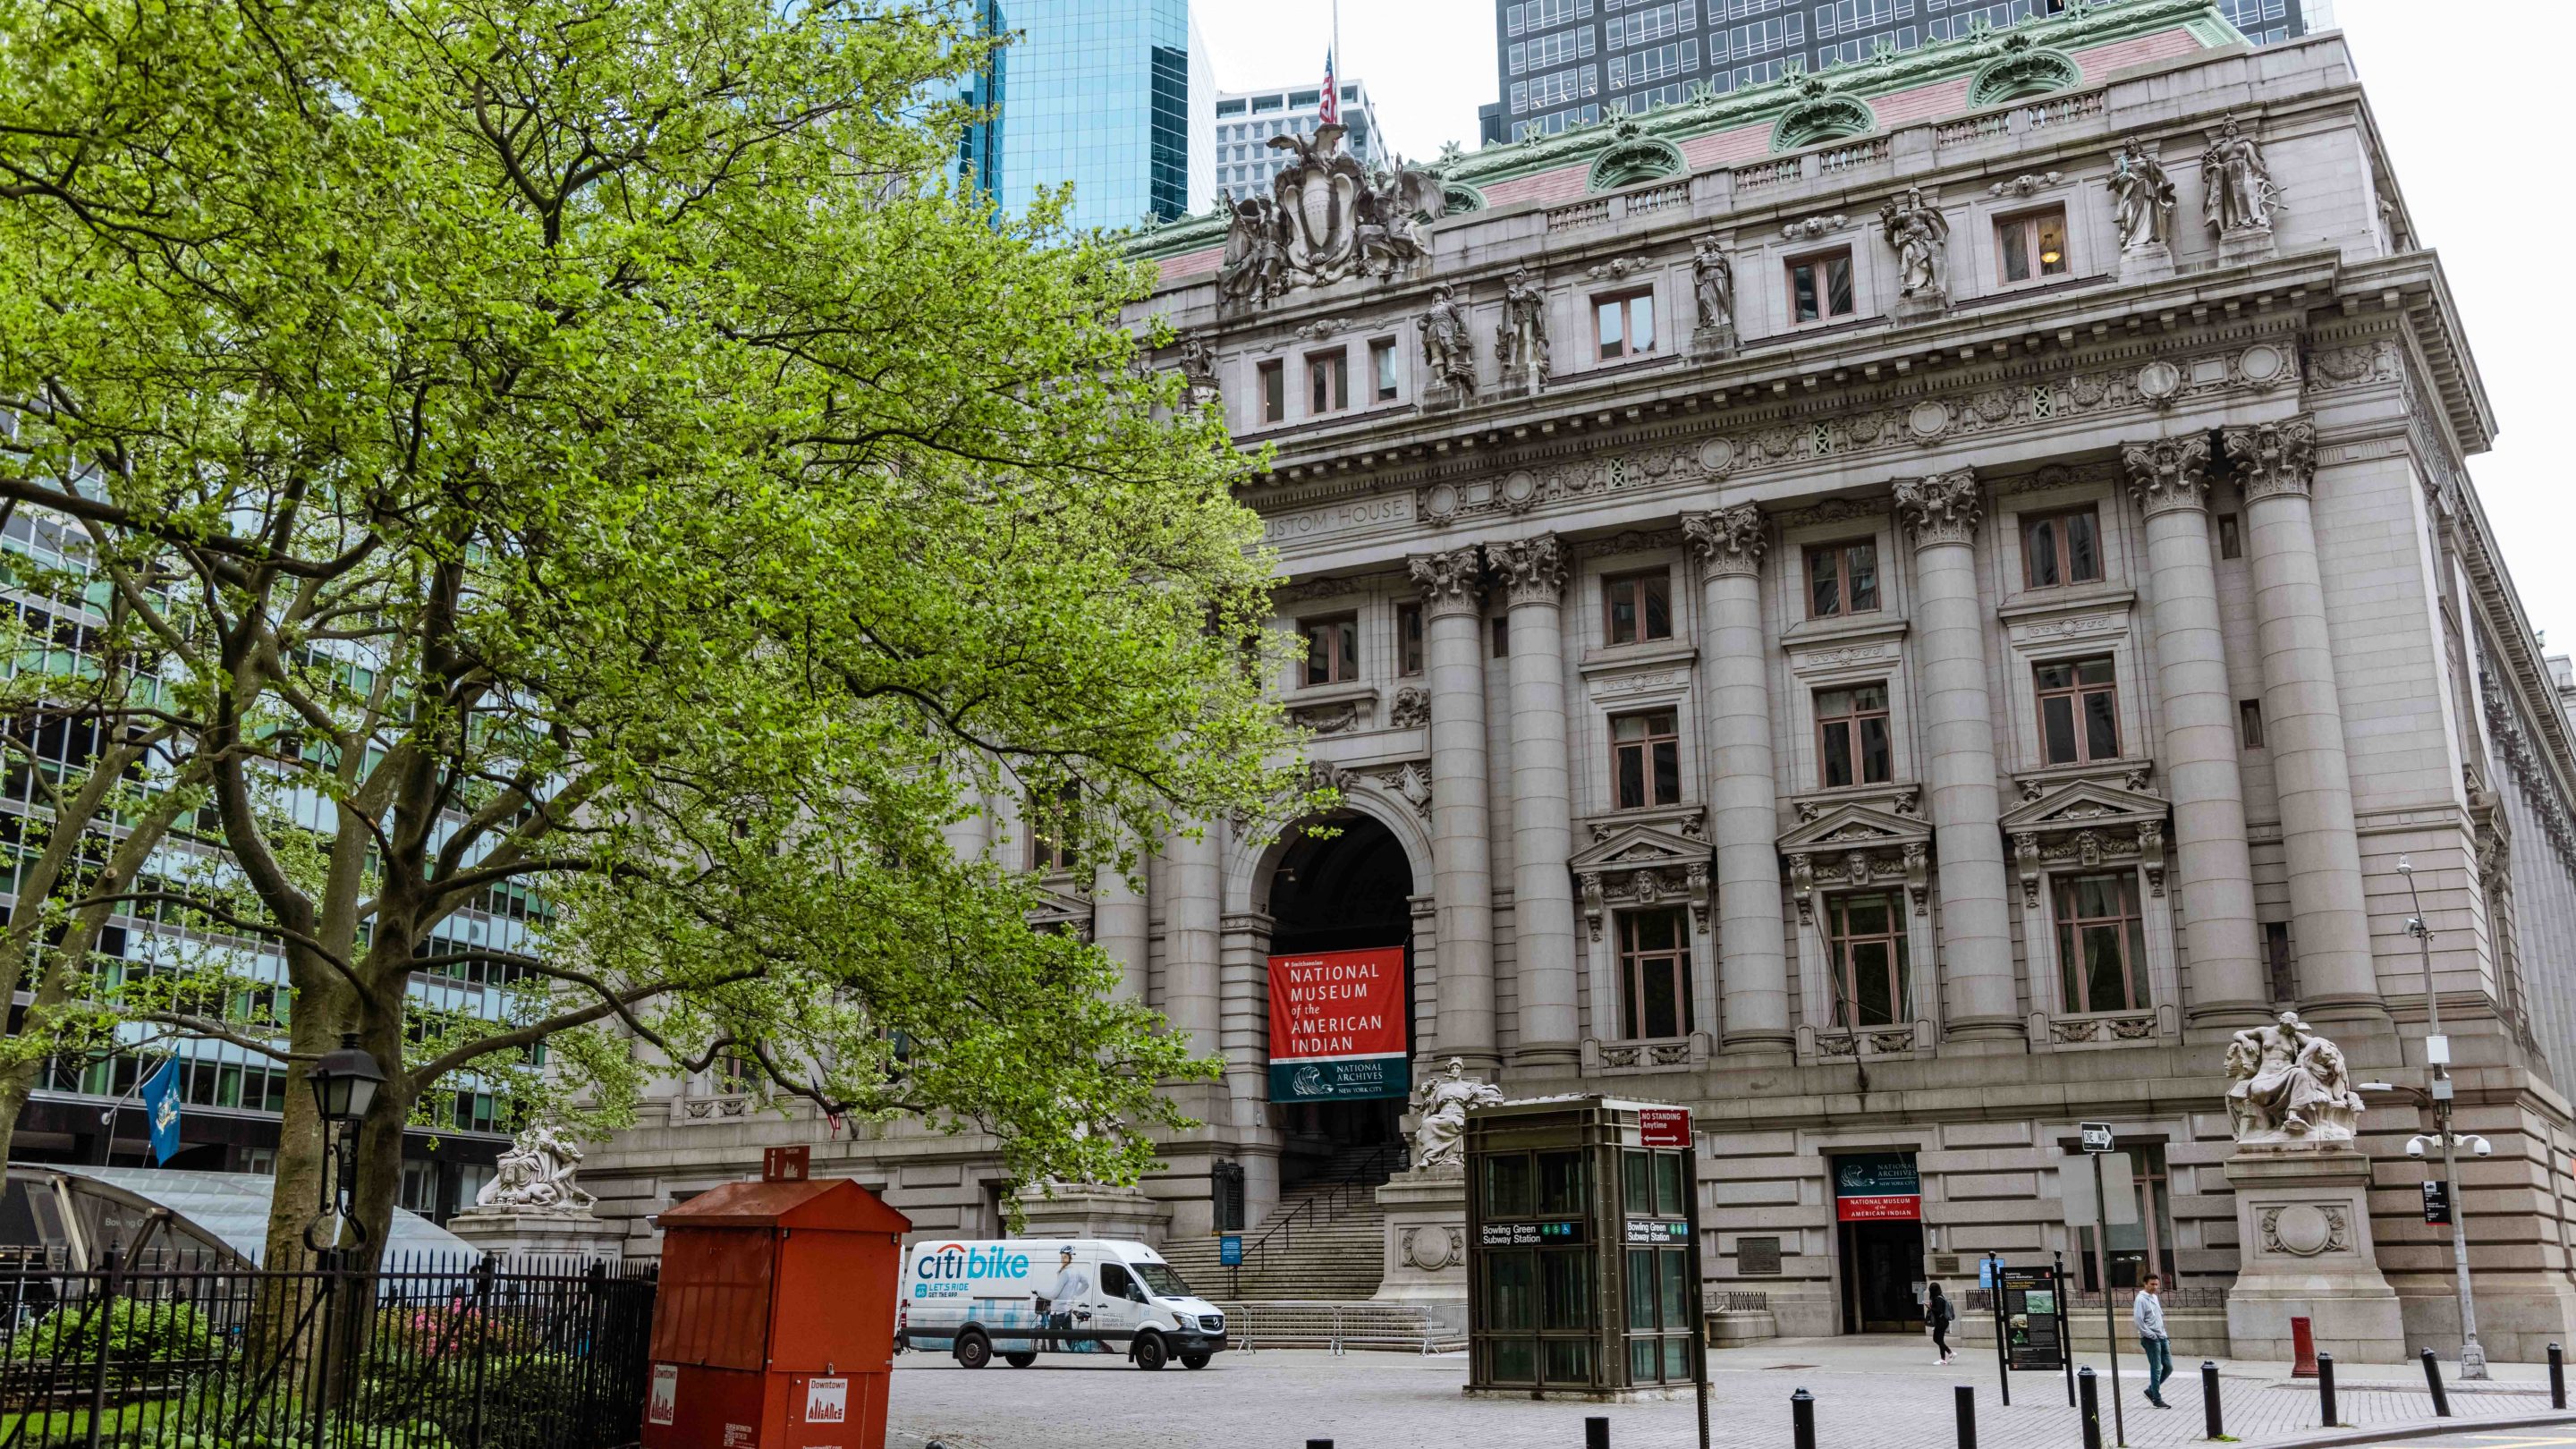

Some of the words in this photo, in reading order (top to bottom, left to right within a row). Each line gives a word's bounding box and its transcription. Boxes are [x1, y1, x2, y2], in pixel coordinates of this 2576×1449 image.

[1264, 512, 1328, 538] USTOM
[1340, 499, 1404, 525] HOUSE
[1291, 960, 1324, 968] Smithsonian
[1291, 963, 1379, 983] NATIONAL
[1291, 983, 1368, 1002] MUSEUM
[1291, 1004, 1301, 1019] of
[1304, 1004, 1320, 1015] the
[1291, 1015, 1382, 1035] AMERICAN
[1292, 1036, 1352, 1054] INDIAN
[1336, 1063, 1383, 1073] NATIONAL
[1337, 1072, 1383, 1082] ARCHIVES
[1651, 1113, 1682, 1121] STANDING
[1642, 1121, 1667, 1130] Anytime
[1877, 1169, 1917, 1177] ARCHIVES
[1482, 1225, 1511, 1235] Bowling
[1513, 1224, 1536, 1233] Green
[1627, 1222, 1648, 1233] Bowling
[1650, 1222, 1666, 1232] Green
[1483, 1235, 1511, 1244] Subway
[1513, 1233, 1540, 1243] Station
[1628, 1232, 1649, 1242] Subway
[1650, 1233, 1670, 1241] Station
[918, 1249, 963, 1279] citi
[967, 1245, 1029, 1279] bike
[928, 1283, 950, 1291] LET'S
[952, 1283, 970, 1291] RIDE
[810, 1379, 845, 1389] Downtown
